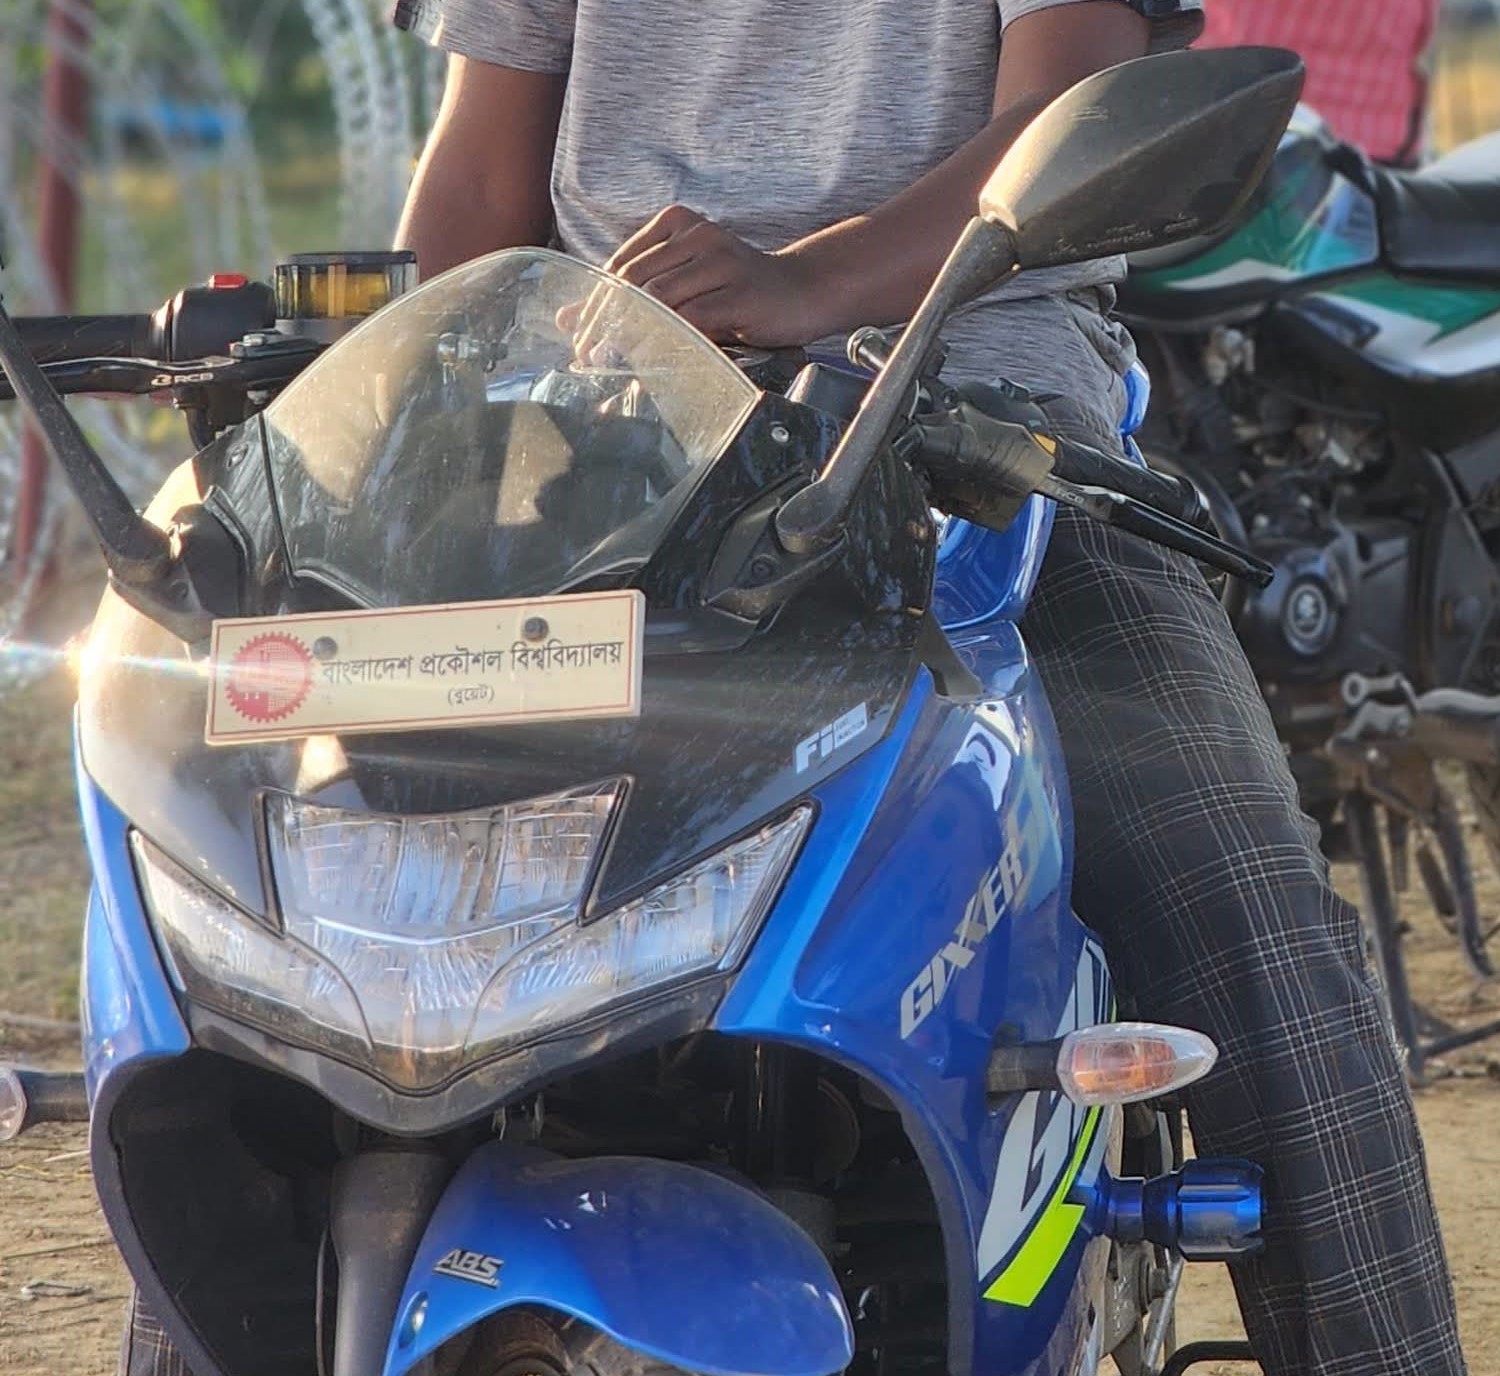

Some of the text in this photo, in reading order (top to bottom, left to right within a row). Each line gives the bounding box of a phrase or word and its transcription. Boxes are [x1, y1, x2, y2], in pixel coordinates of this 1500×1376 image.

[322, 638, 624, 684] বাংলাদেশ প্রকৌশল বিশ্ববিদ্যালয়
[434, 1247, 504, 1281] ABS
